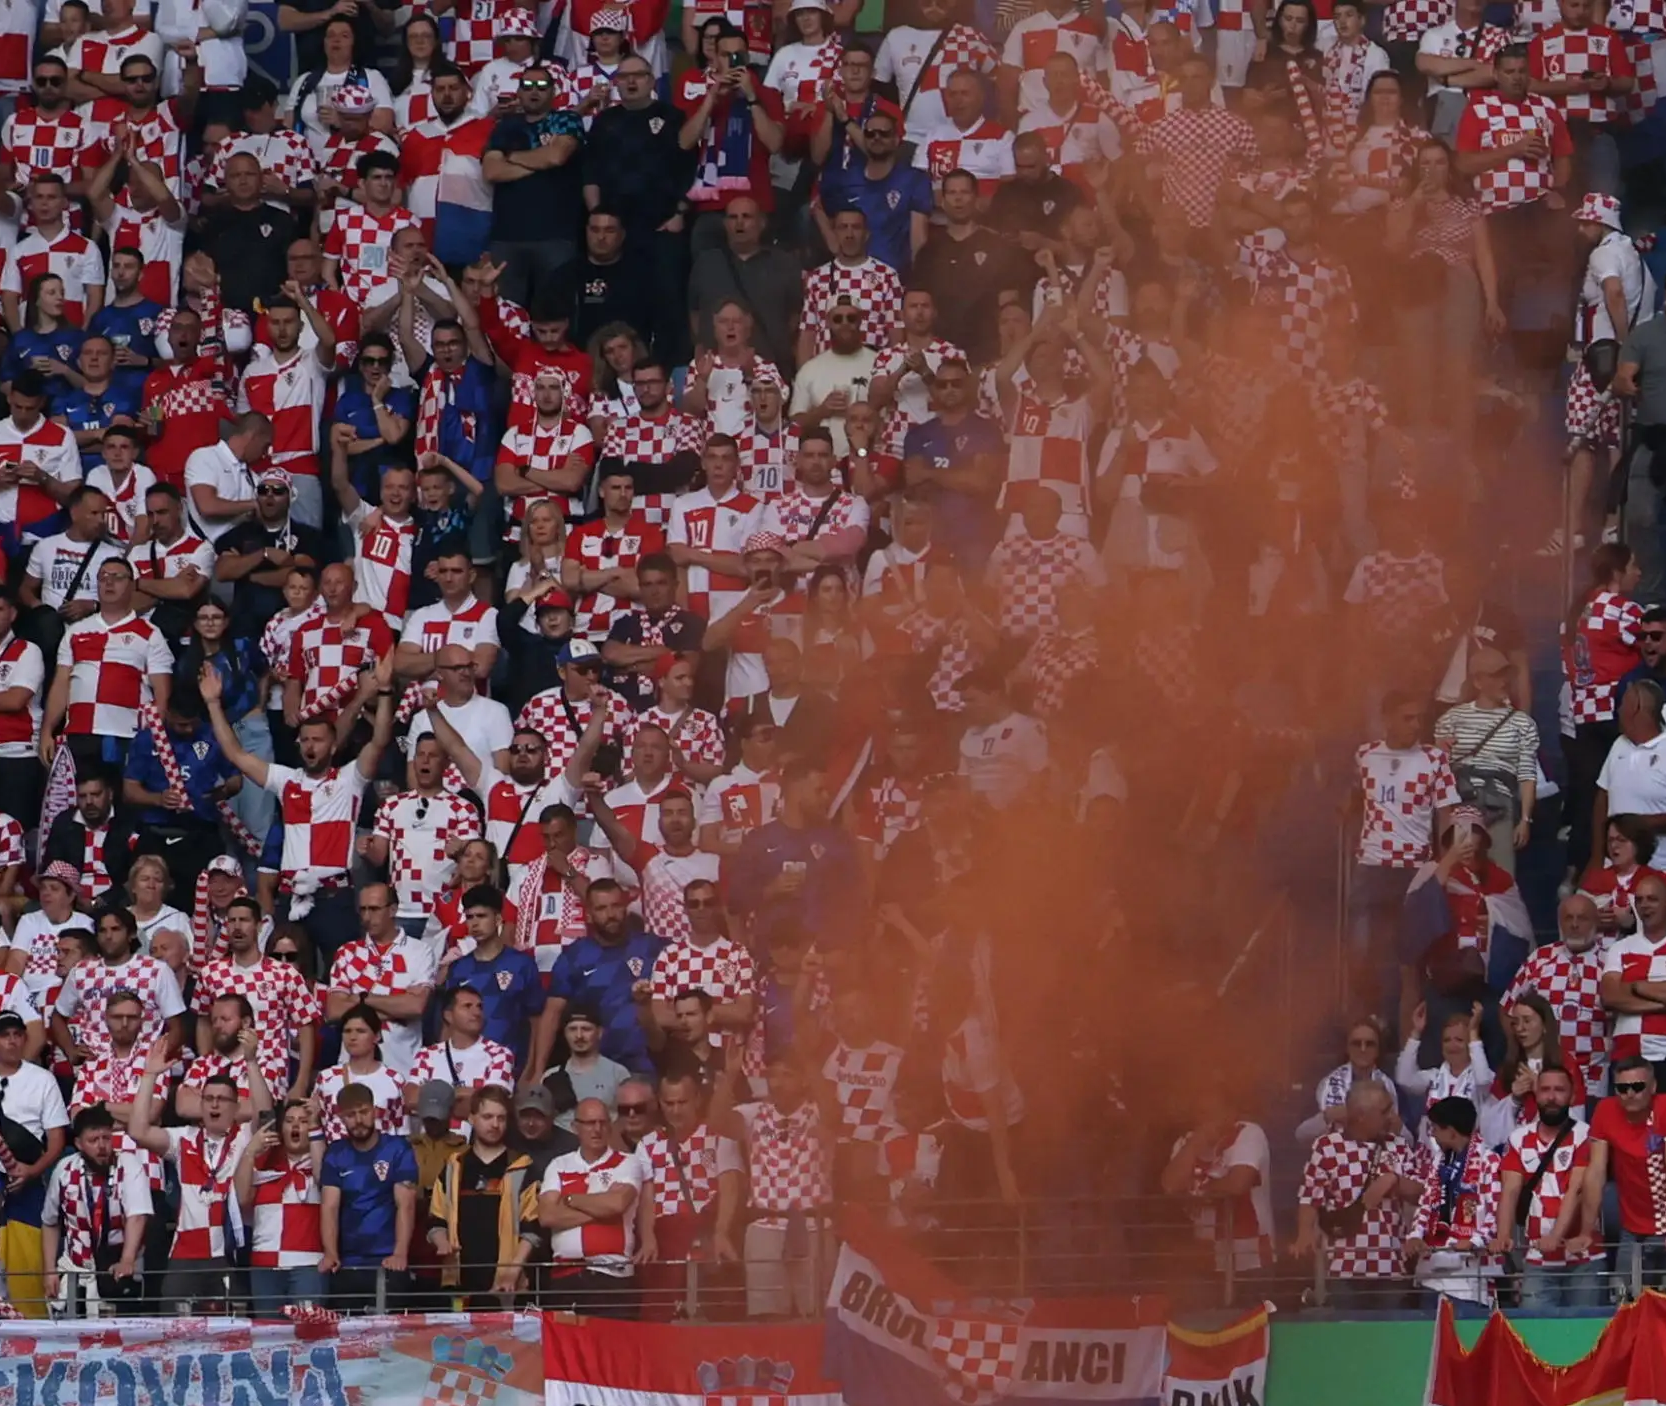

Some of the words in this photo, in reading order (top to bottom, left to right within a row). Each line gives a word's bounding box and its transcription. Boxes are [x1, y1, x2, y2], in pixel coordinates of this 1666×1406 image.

[474, 2, 492, 19] 21
[1549, 56, 1559, 73] 6
[36, 148, 49, 166] 10
[361, 245, 385, 267] 20
[758, 467, 778, 489] 10
[689, 520, 709, 546] 10
[370, 534, 391, 559] 10
